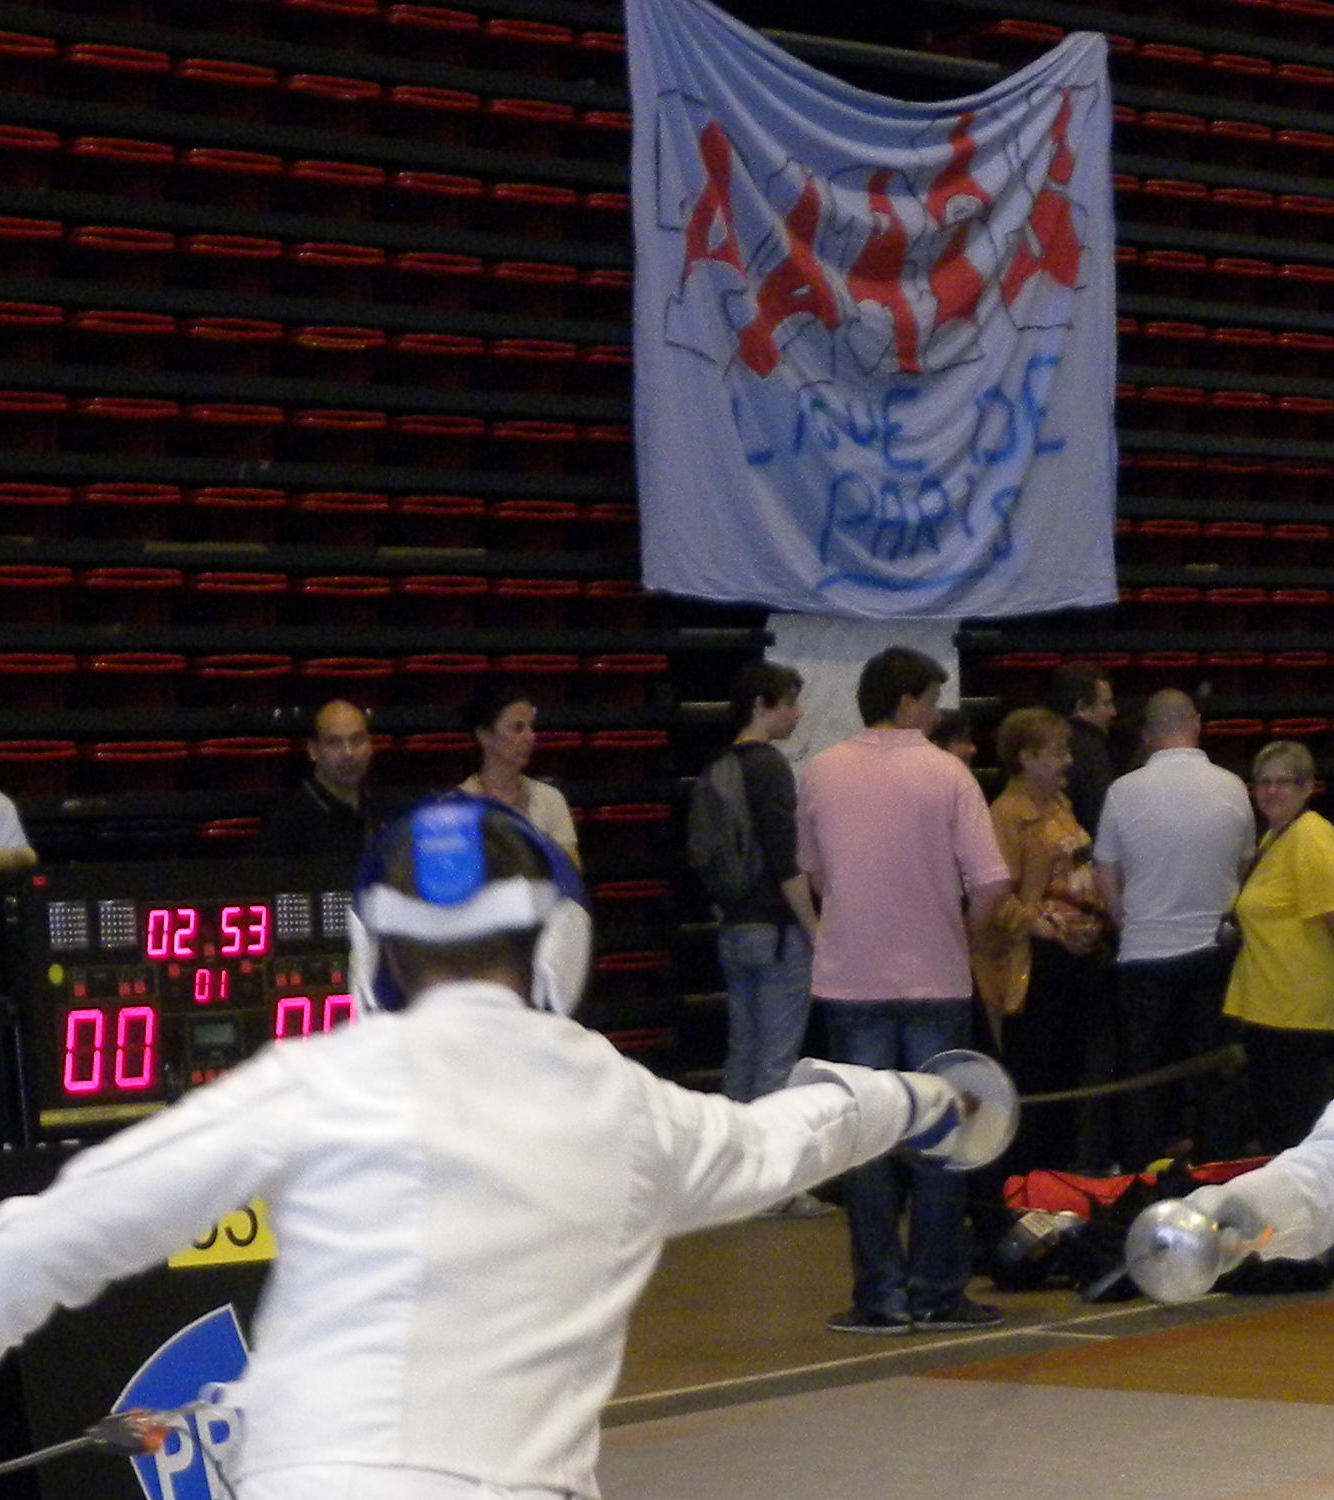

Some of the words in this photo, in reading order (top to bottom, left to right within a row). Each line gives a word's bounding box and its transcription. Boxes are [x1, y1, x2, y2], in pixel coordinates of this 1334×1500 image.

[970, 355, 1064, 465] DE
[819, 470, 1021, 565] PARIS
[193, 967, 229, 1003] 01
[63, 1004, 157, 1094] 00
